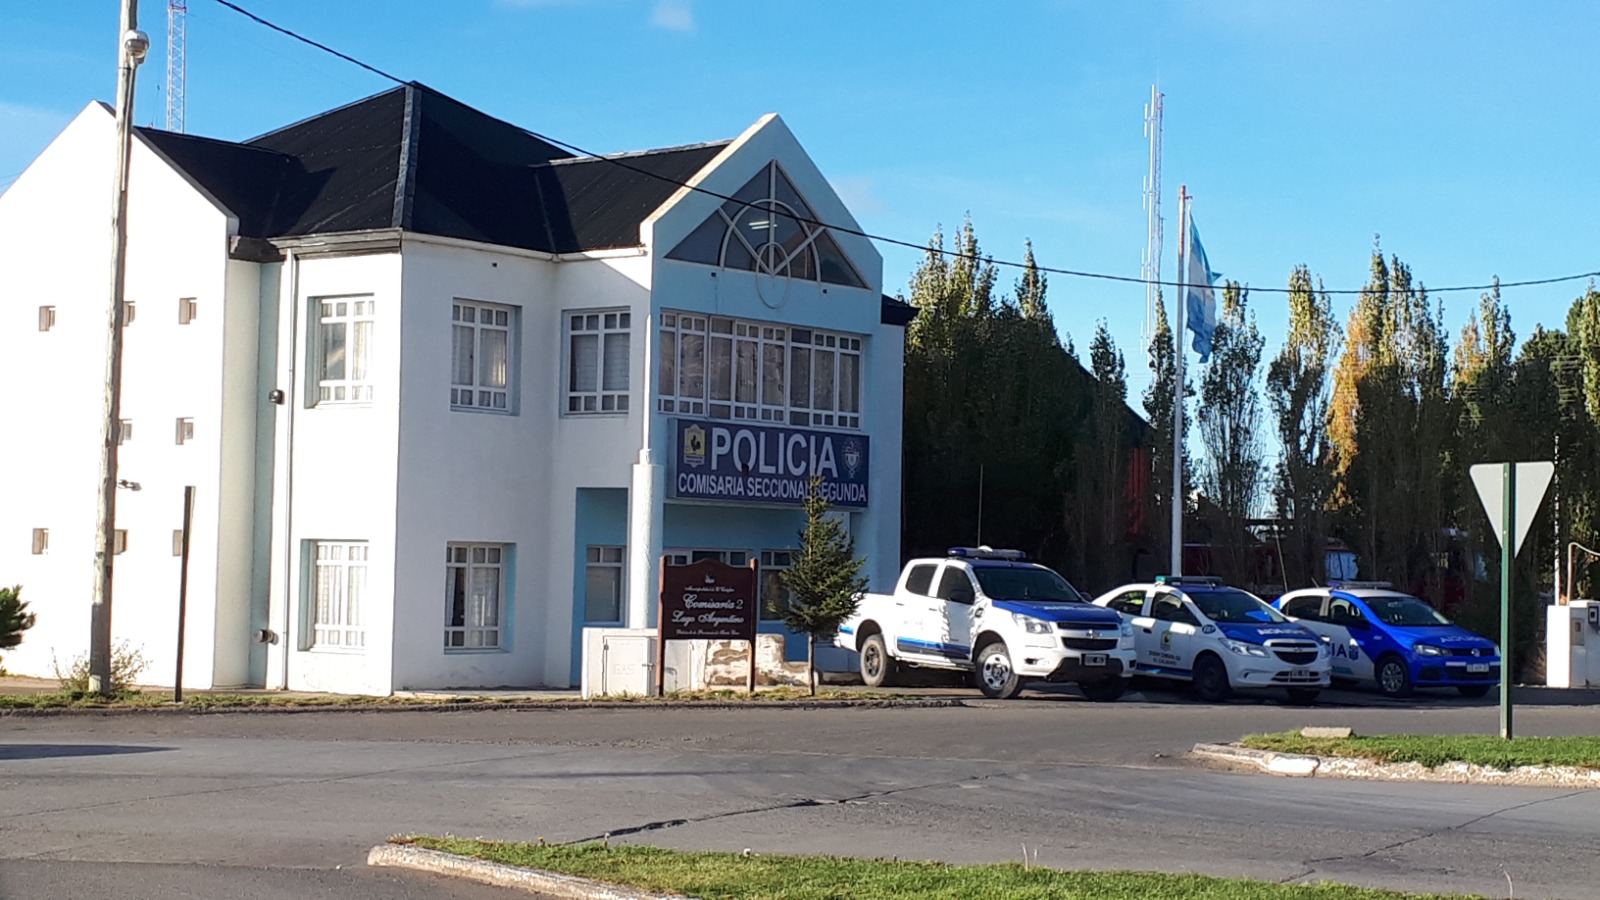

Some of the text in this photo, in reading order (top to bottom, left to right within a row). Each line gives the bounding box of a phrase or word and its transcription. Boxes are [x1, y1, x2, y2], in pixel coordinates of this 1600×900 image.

[711, 427, 839, 478] POLICIA
[678, 472, 867, 502] COMISARIA SECCIONAL SEGUNDA
[736, 599, 744, 610] 2
[671, 610, 745, 627] Lago Argentino
